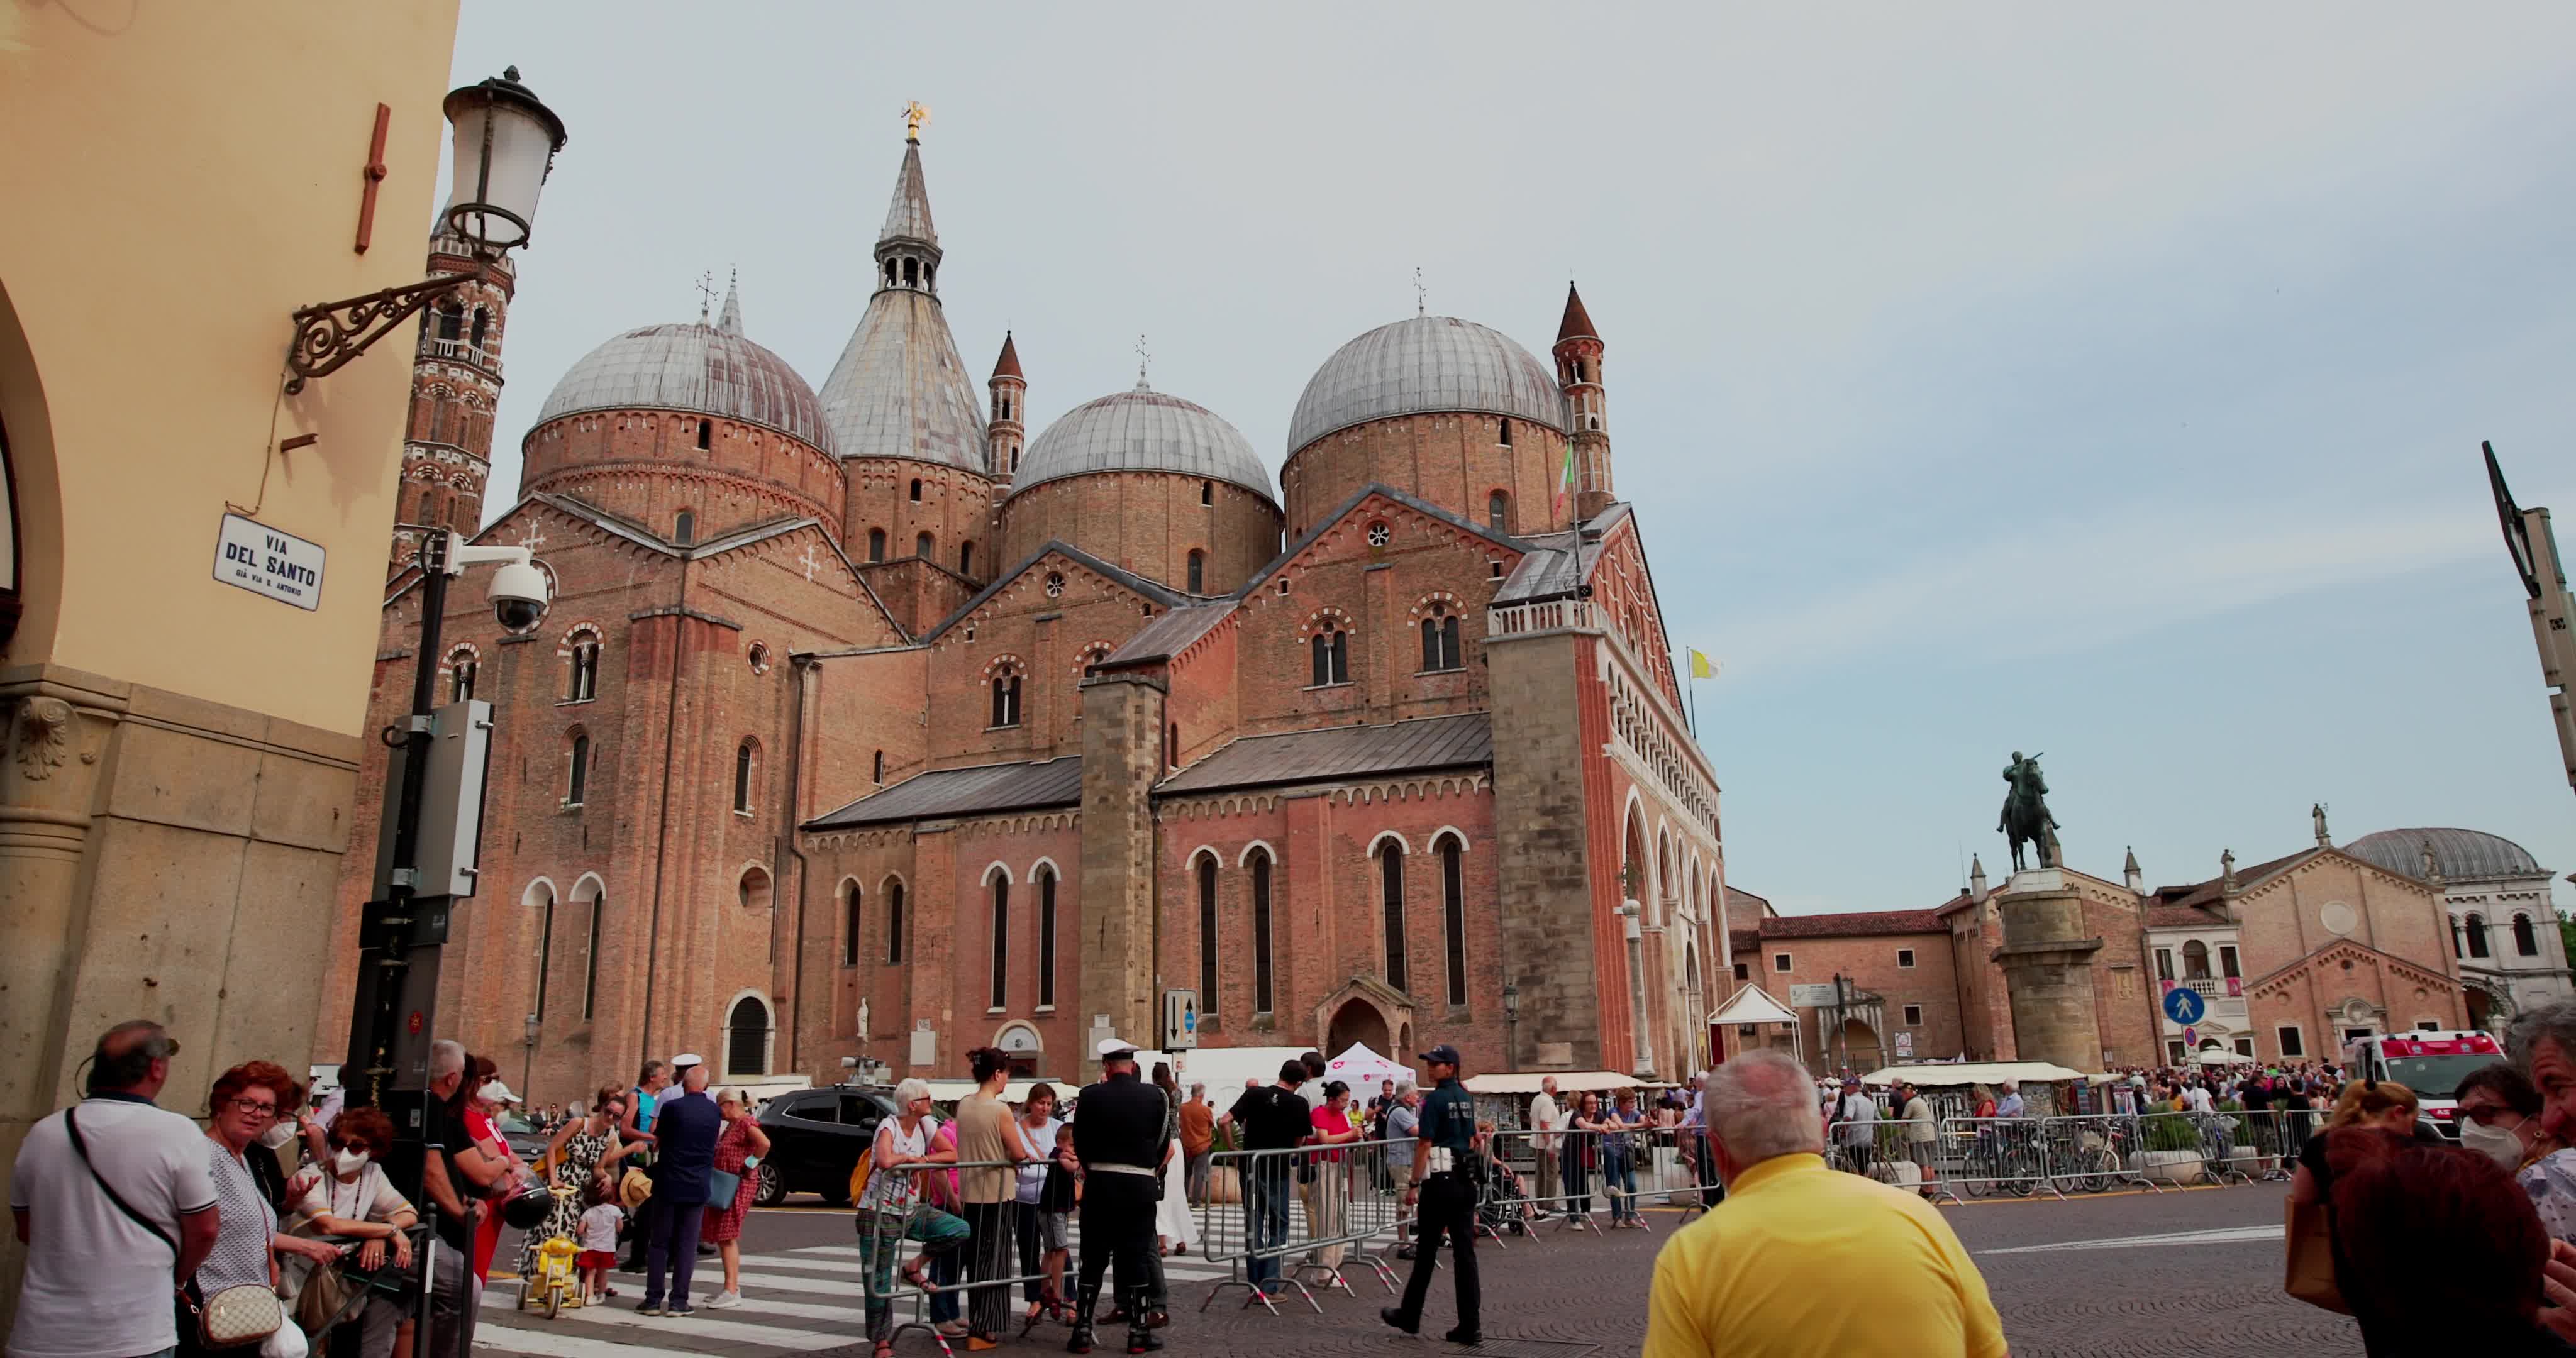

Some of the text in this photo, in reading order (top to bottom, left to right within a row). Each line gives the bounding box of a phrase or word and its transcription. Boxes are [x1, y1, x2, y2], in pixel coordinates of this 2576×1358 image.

[267, 535, 287, 555] VIA
[226, 543, 315, 587] DEL SANTO
[252, 575, 262, 583] VIA
[277, 583, 302, 596] ANTONIO
